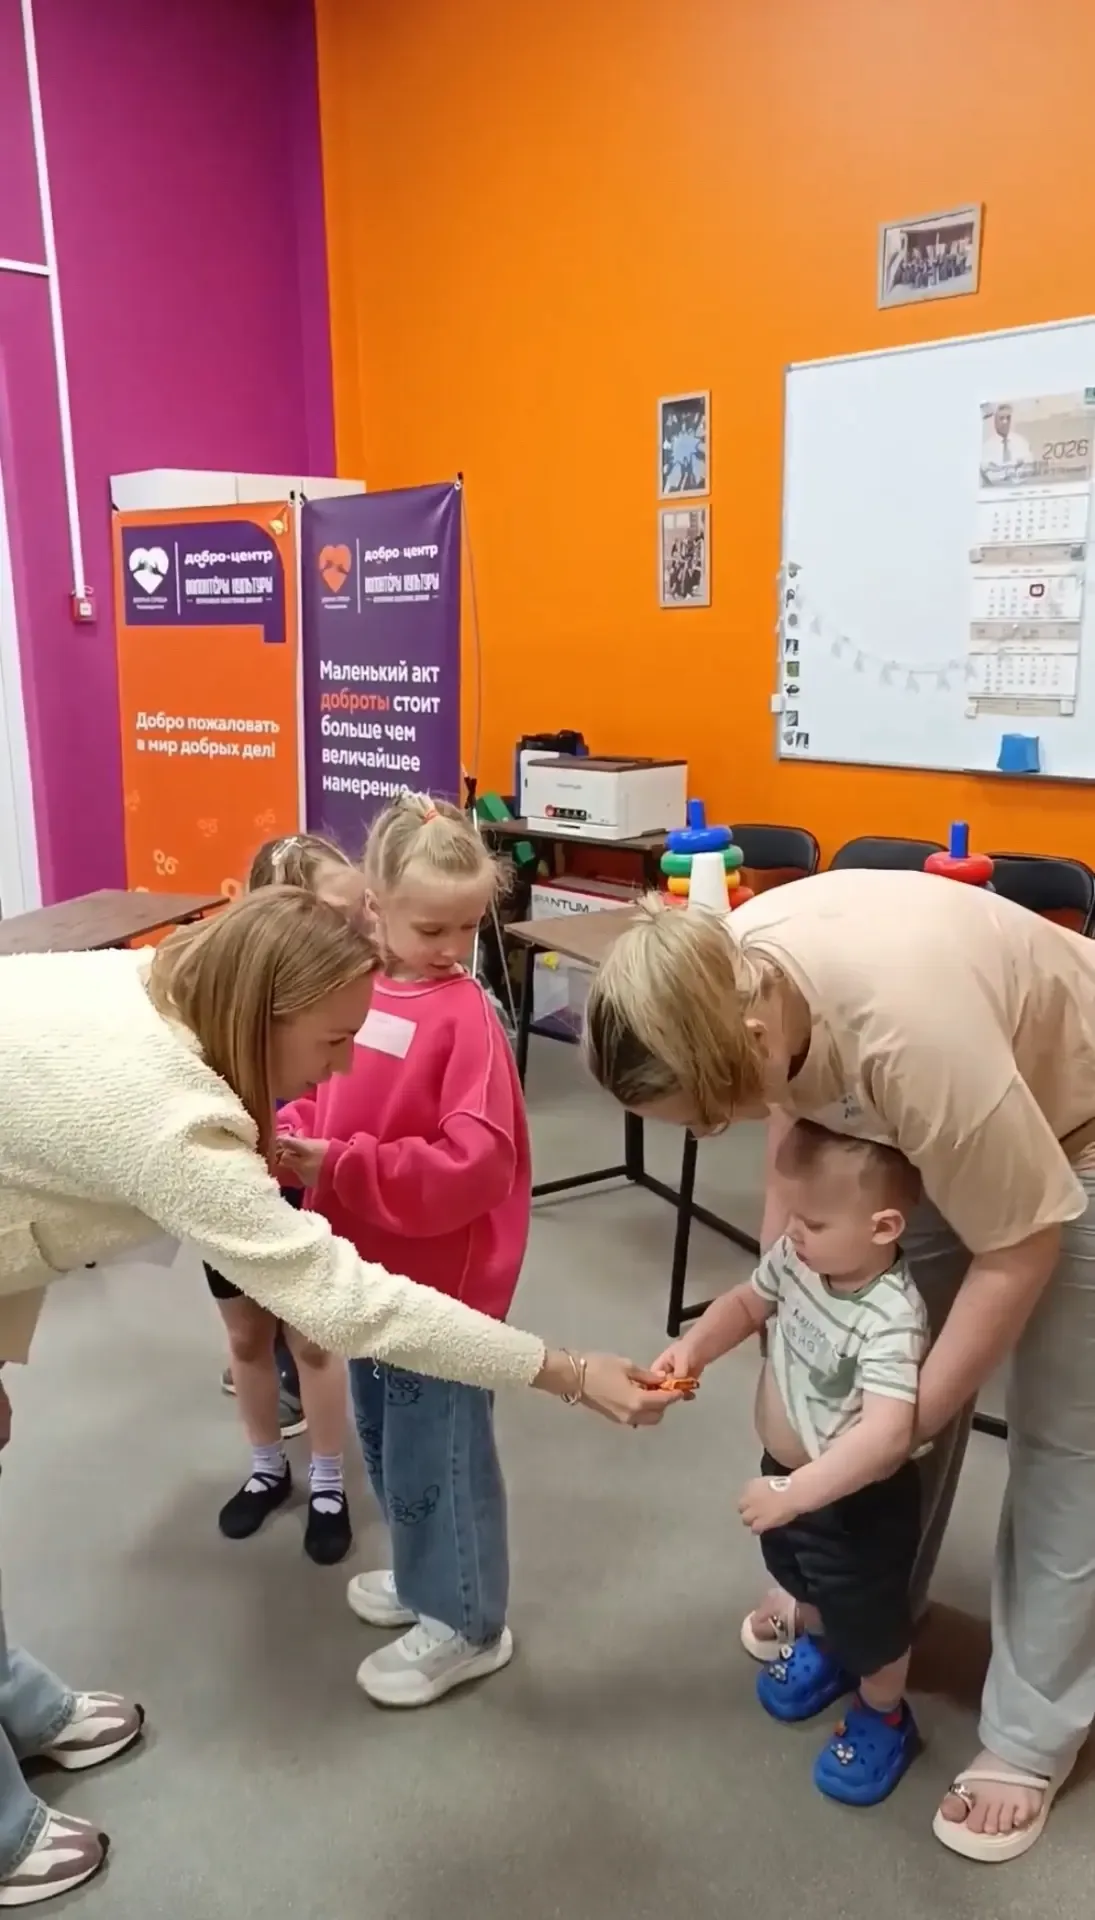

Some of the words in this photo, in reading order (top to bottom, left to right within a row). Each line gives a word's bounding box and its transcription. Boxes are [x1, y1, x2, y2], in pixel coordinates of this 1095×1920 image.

[1042, 439, 1088, 460] 2026
[364, 546, 400, 562] добро
[403, 545, 439, 559] центр
[320, 660, 408, 682] Маленький
[412, 666, 440, 683] акт
[320, 687, 390, 715] доброты
[393, 695, 441, 713] стоит
[136, 712, 185, 733] Добро
[187, 716, 280, 733] пожаловать
[321, 714, 382, 739] больше
[385, 724, 416, 742] чем
[148, 739, 177, 756] мир
[180, 736, 239, 759] добрых
[322, 747, 420, 772] величайшее
